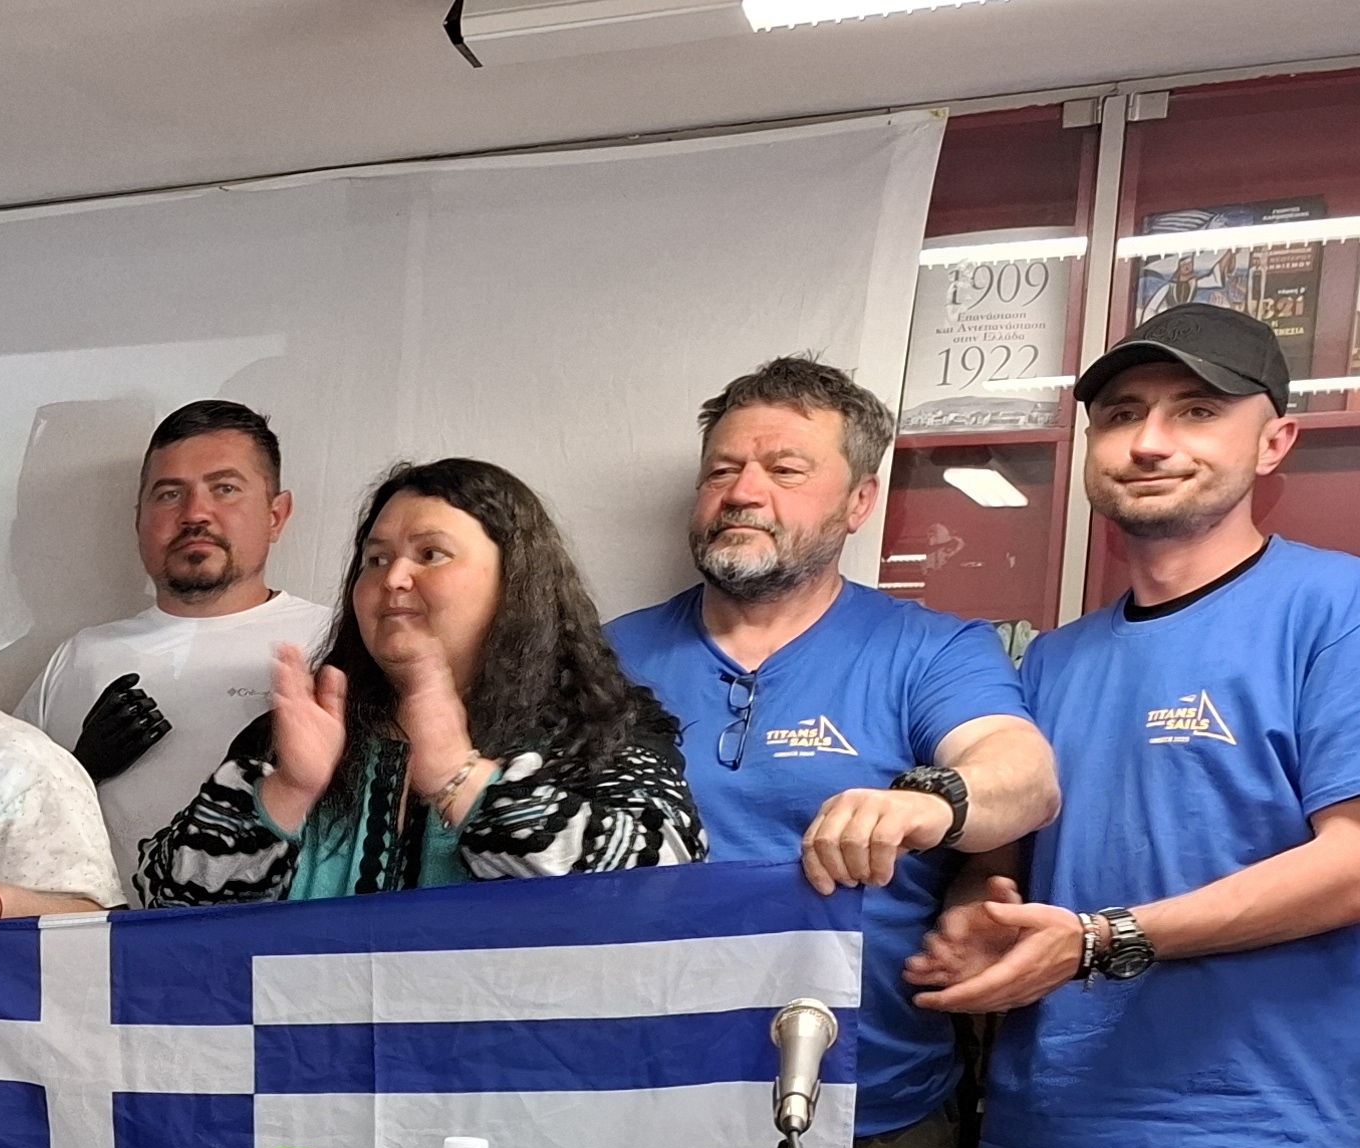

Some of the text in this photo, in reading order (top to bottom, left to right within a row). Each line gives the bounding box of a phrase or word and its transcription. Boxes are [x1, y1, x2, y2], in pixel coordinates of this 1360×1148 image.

[947, 261, 1049, 311] 1909
[956, 312, 1027, 323] Επανάσταση
[935, 321, 1047, 334] και Αντεπανάσταση
[952, 331, 1025, 344] στην Ελλάδα
[936, 344, 1039, 391] 1922
[1147, 707, 1198, 722] TITANS
[1165, 718, 1210, 730] SAILS
[766, 728, 818, 740] TITANS
[789, 737, 832, 747] SAILS
